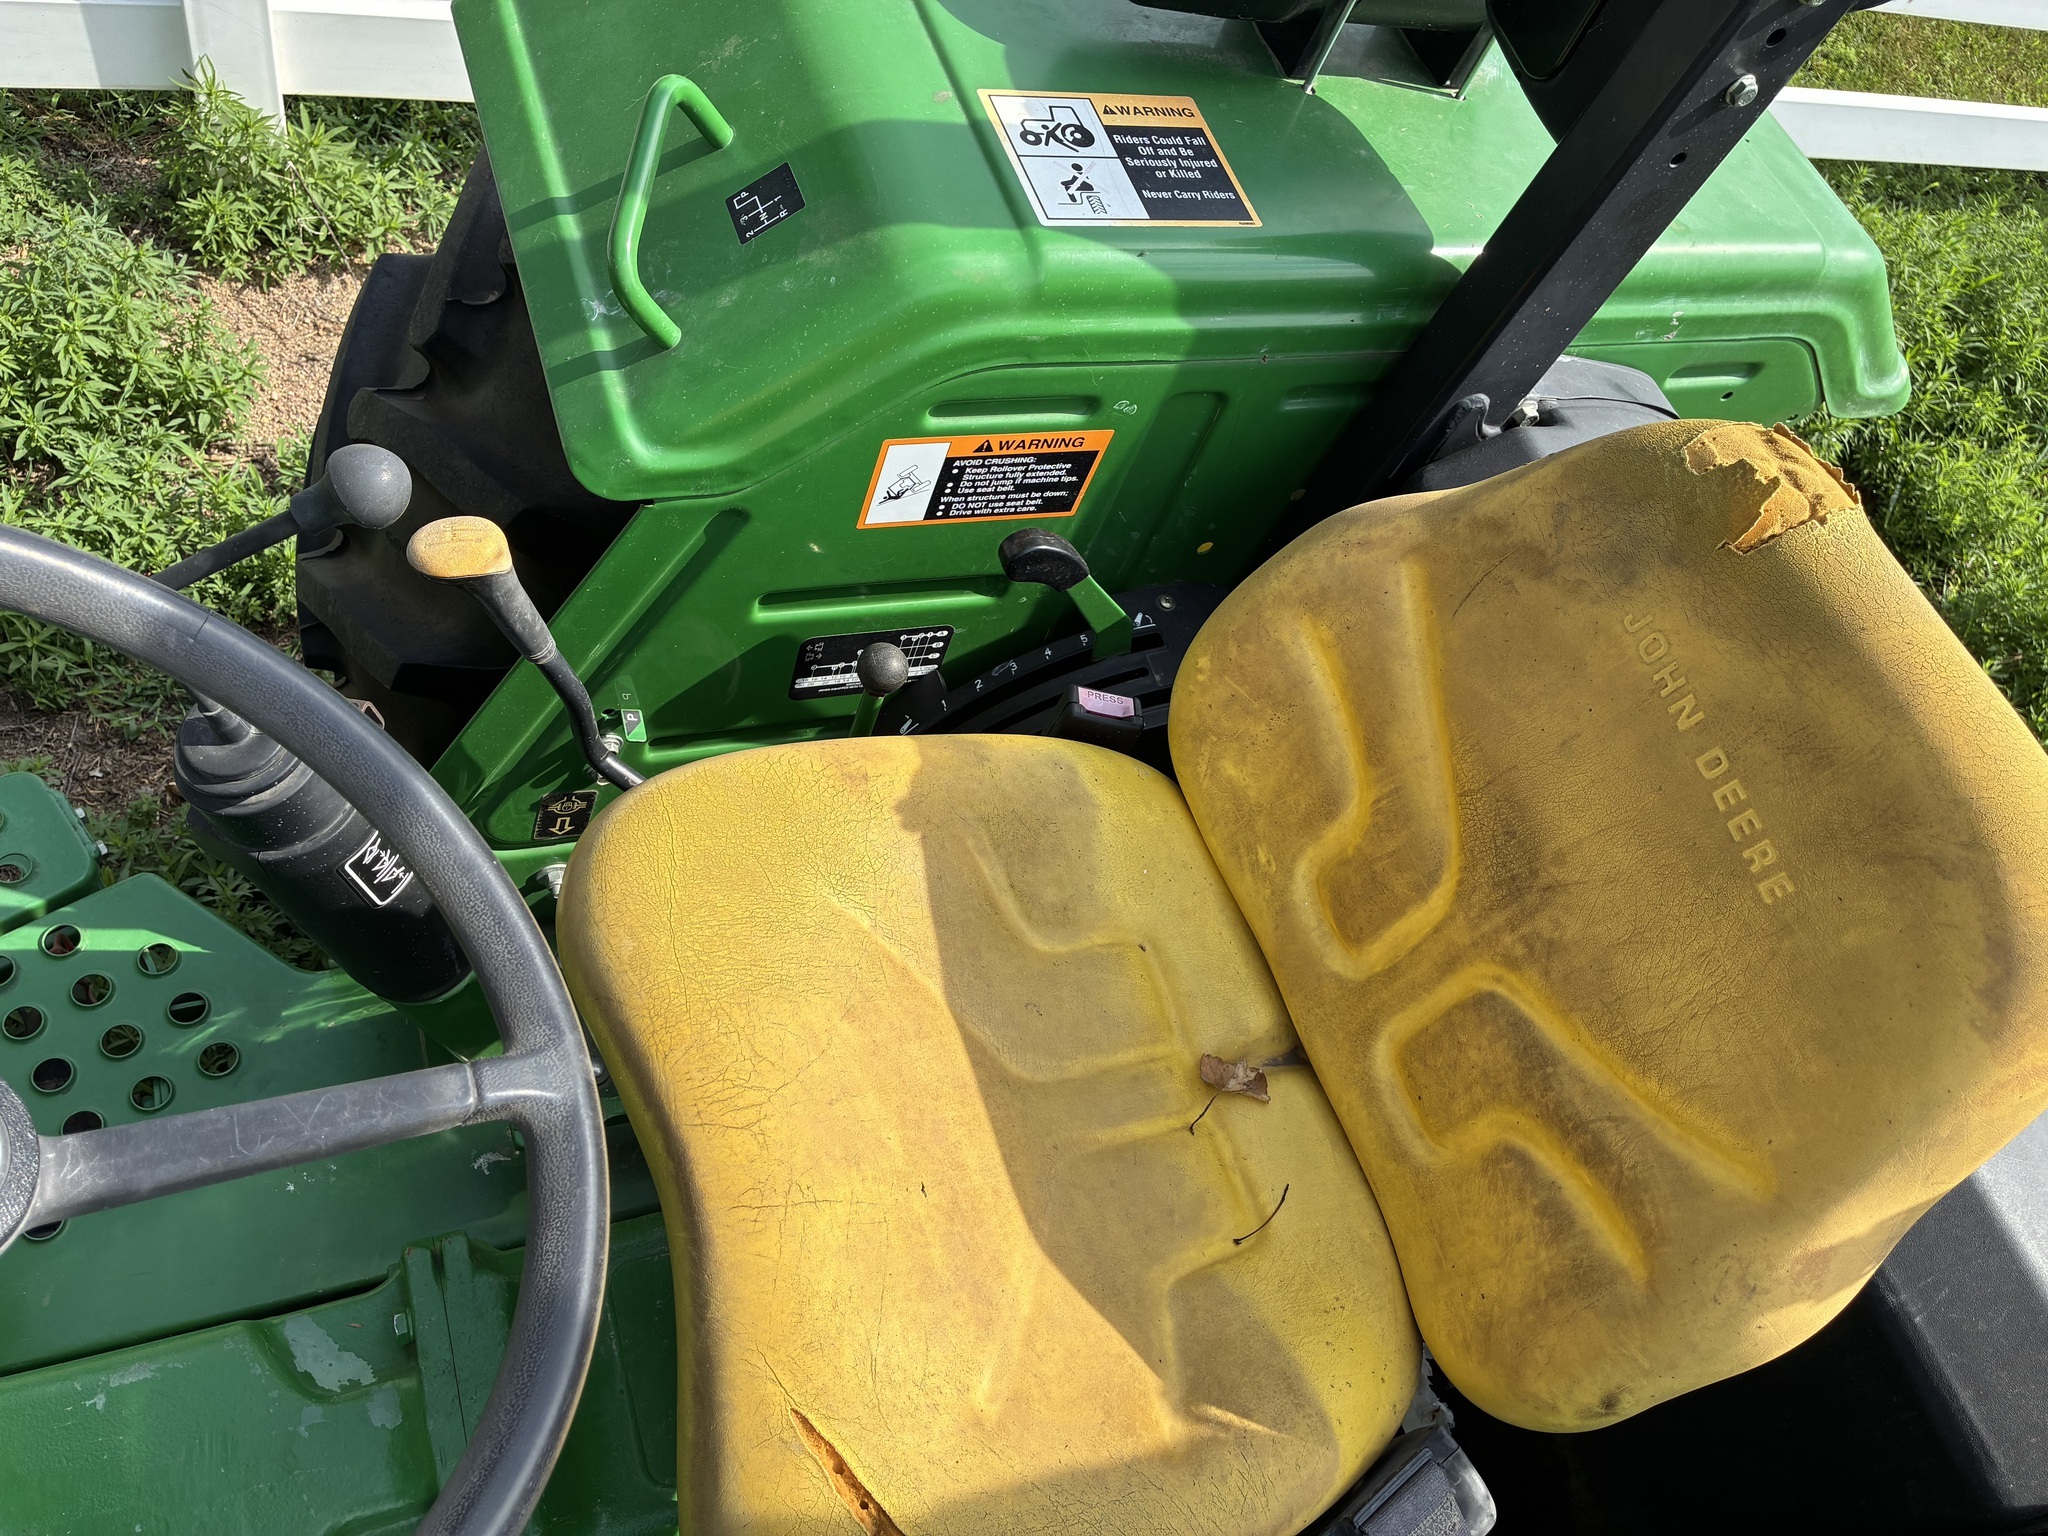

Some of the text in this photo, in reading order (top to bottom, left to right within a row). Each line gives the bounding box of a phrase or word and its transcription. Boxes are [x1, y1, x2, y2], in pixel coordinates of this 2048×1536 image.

[1115, 106, 1195, 118] WARNING
[1113, 134, 1206, 146] Riders Could Fall
[1138, 146, 1194, 156] Off and Be
[1125, 157, 1218, 169] Seriously Injured
[1169, 169, 1202, 178] Killed
[1142, 190, 1236, 200] Never Carry Riders
[780, 209, 788, 218] R
[999, 437, 1085, 450] WARNING
[985, 457, 1037, 465] CRUSHING:
[1080, 634, 1088, 643] 5
[1044, 648, 1052, 656] 4
[1010, 662, 1018, 671] 3
[974, 680, 983, 688] 2
[1088, 690, 1124, 704] PRESS
[1624, 613, 1796, 904] JOHN DEERE
